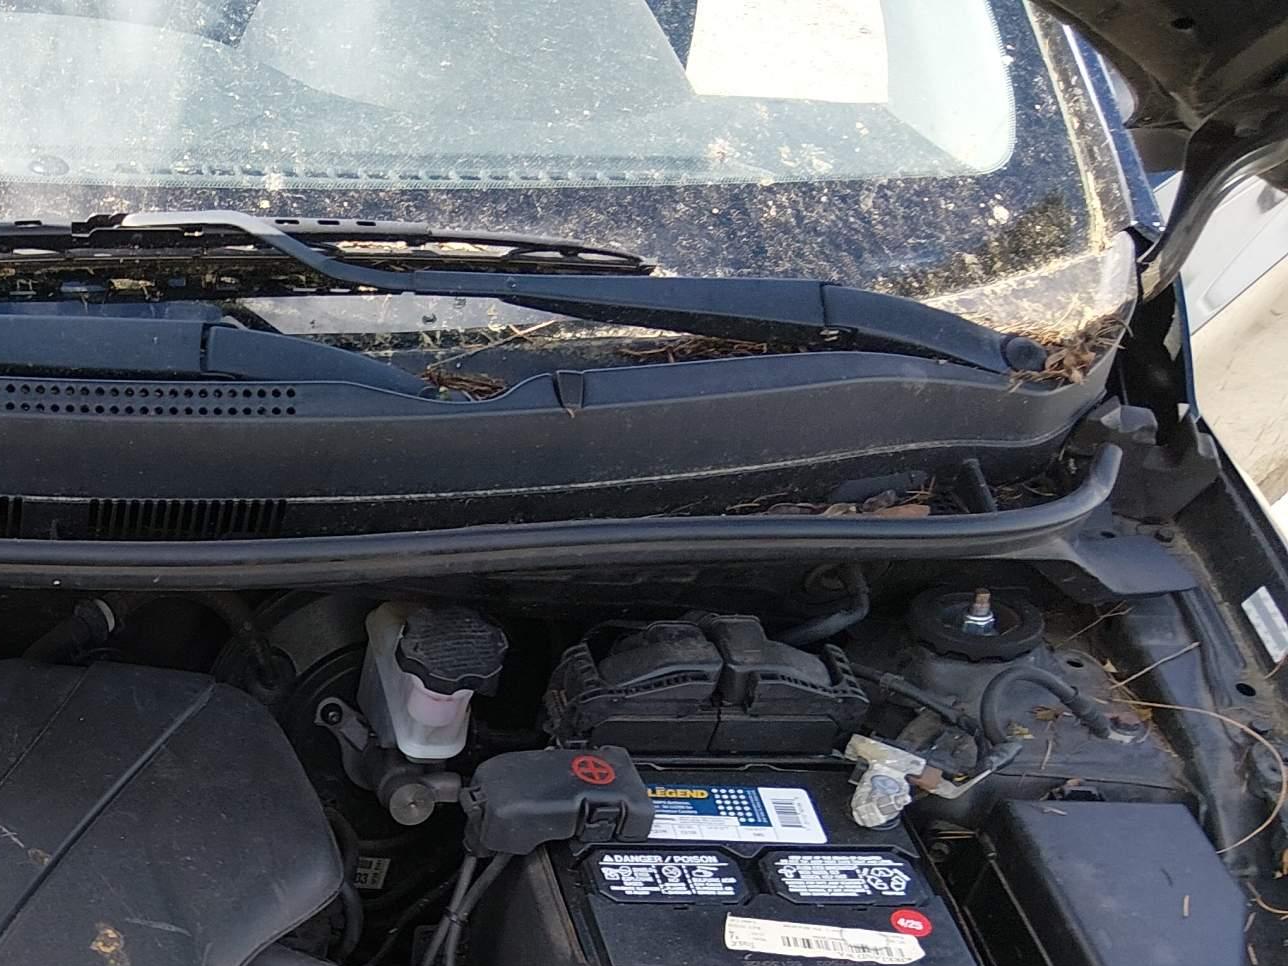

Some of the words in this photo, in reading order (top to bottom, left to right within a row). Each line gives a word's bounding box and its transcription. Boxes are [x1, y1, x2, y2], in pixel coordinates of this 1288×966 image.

[647, 789, 708, 799] LEGEND
[614, 855, 662, 863] DANGER
[673, 855, 718, 863] POISON
[896, 917, 924, 931] 4/25
